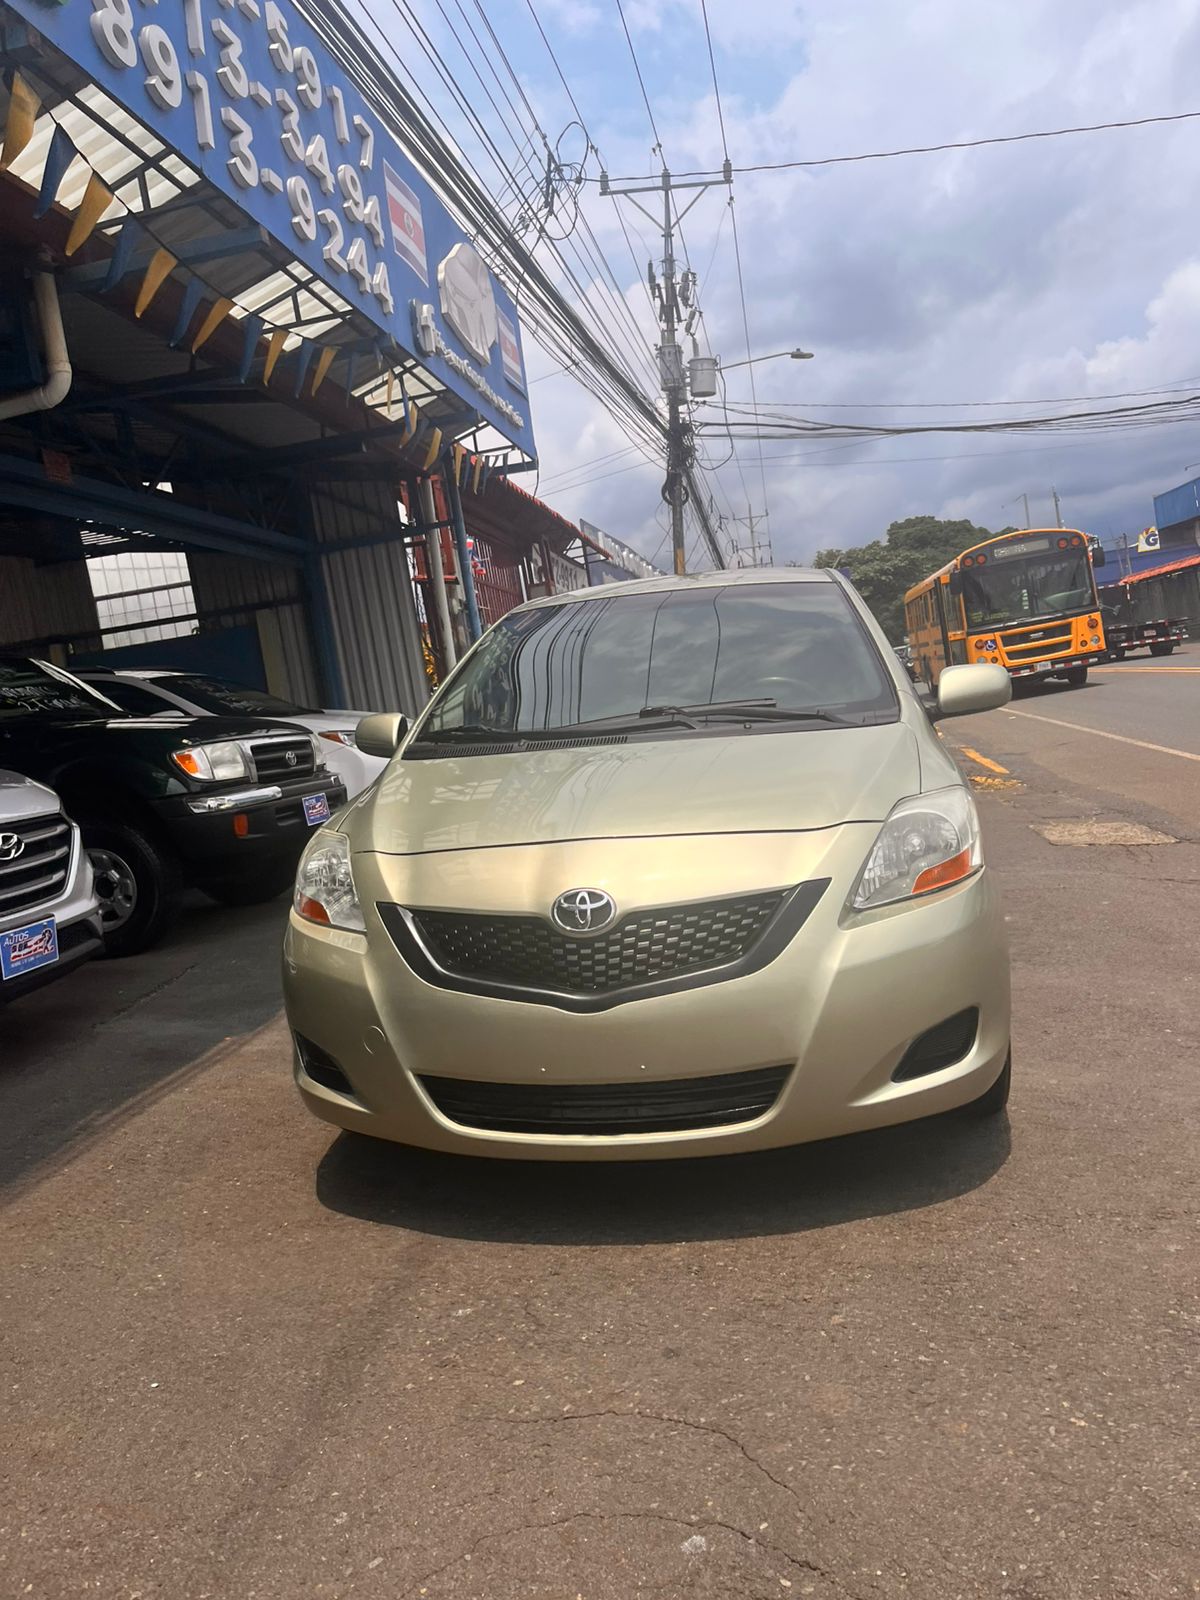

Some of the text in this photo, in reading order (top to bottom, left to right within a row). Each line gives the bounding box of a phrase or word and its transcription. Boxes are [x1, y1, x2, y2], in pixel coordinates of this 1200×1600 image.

[90, 0, 394, 314] 8913-9244
[140, 0, 384, 248] 13-3494
[3, 930, 30, 947] AUTOS
